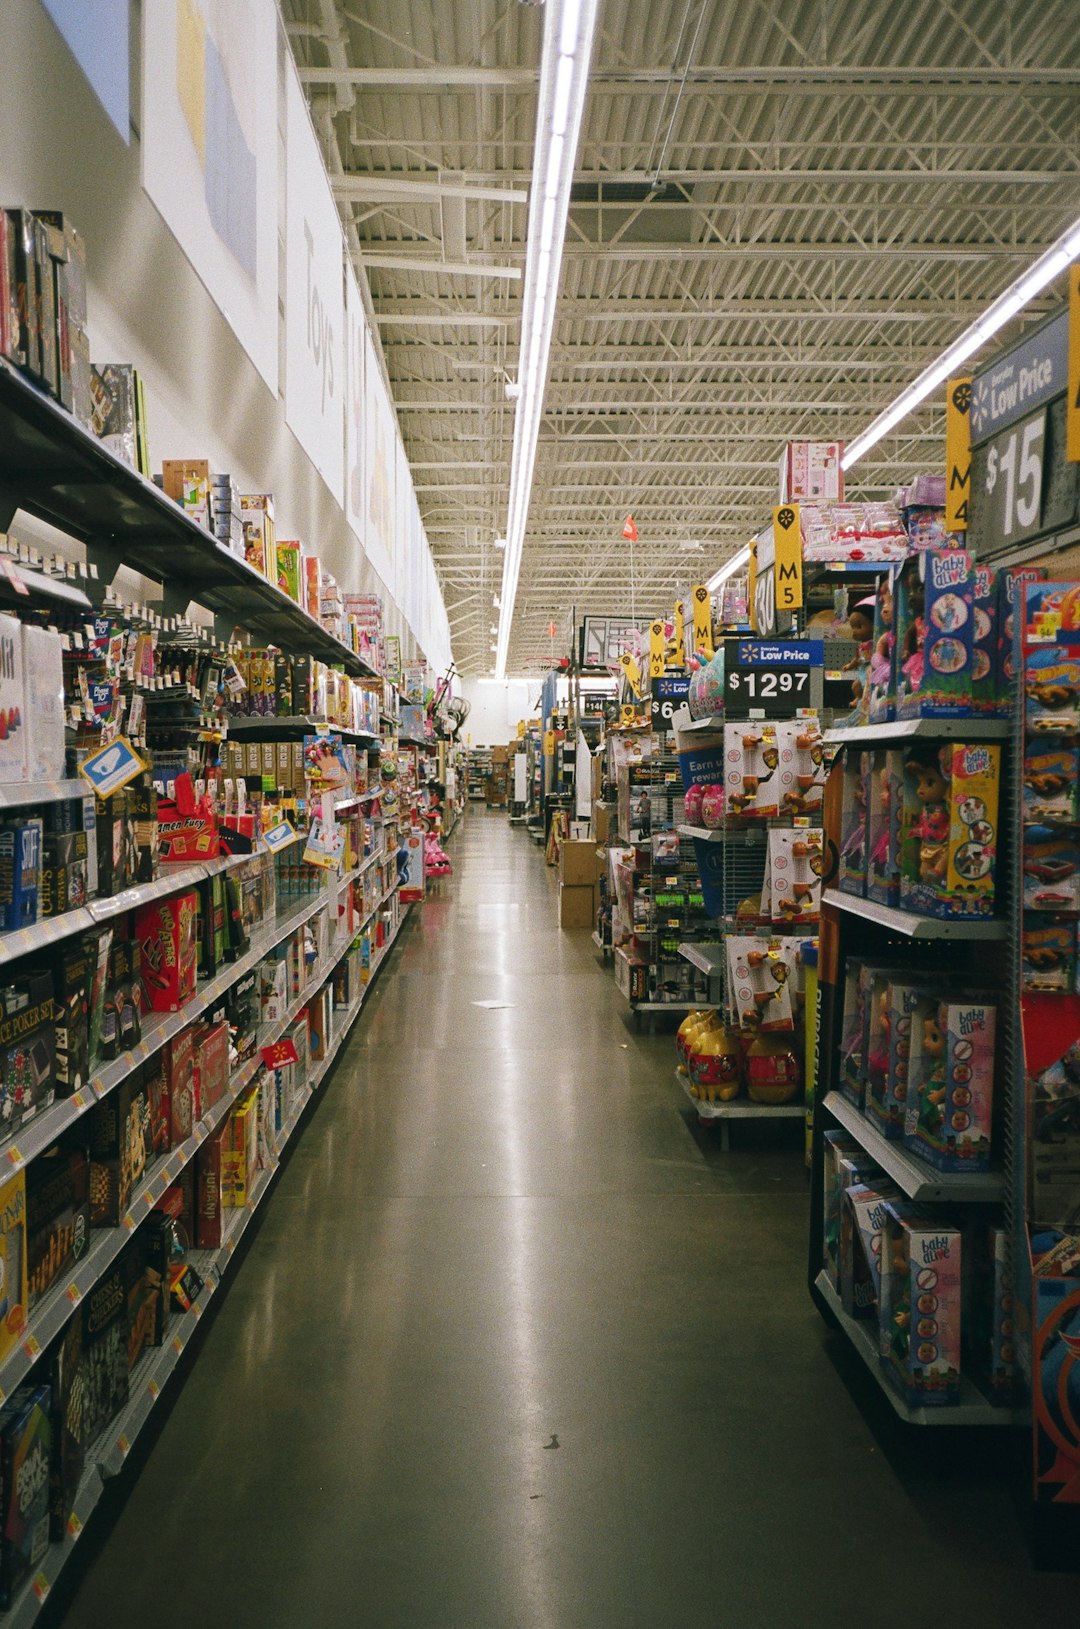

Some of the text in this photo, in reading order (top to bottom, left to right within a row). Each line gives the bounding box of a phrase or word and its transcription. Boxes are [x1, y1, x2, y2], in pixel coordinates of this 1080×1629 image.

[991, 358, 1053, 420] Low Price
[779, 561, 798, 581] M
[934, 554, 966, 573] baby
[784, 587, 794, 604] 5
[696, 626, 709, 639] M
[652, 654, 663, 663] M
[760, 650, 810, 660] Low Price
[653, 665, 660, 675] 9
[689, 760, 713, 773] Earn
[158, 816, 205, 833] amen Fury
[158, 904, 176, 968] UNO ATTACK
[12, 1005, 41, 1036] POKER
[40, 997, 55, 1024] SET
[960, 1008, 985, 1024] baby
[203, 1169, 216, 1220] JUMANJI
[922, 1236, 949, 1254] baby
